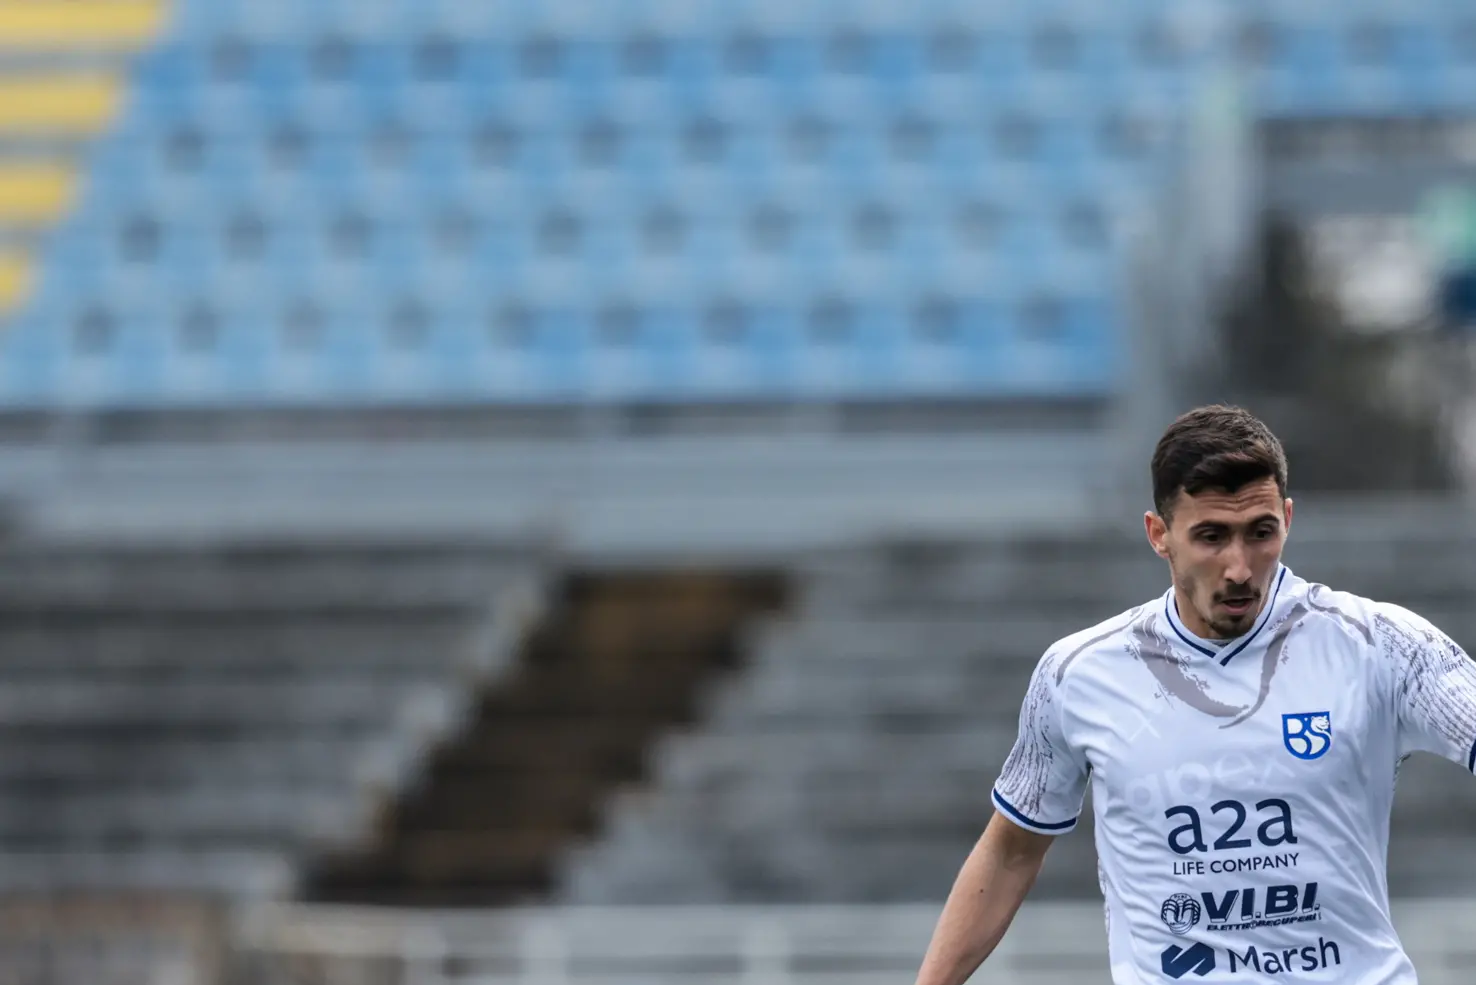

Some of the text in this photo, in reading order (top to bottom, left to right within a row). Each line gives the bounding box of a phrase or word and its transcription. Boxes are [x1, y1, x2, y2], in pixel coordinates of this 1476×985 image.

[1164, 798, 1299, 855] a2a
[1173, 852, 1300, 876] LIFE COMPANY
[1229, 937, 1342, 975] Marsh
